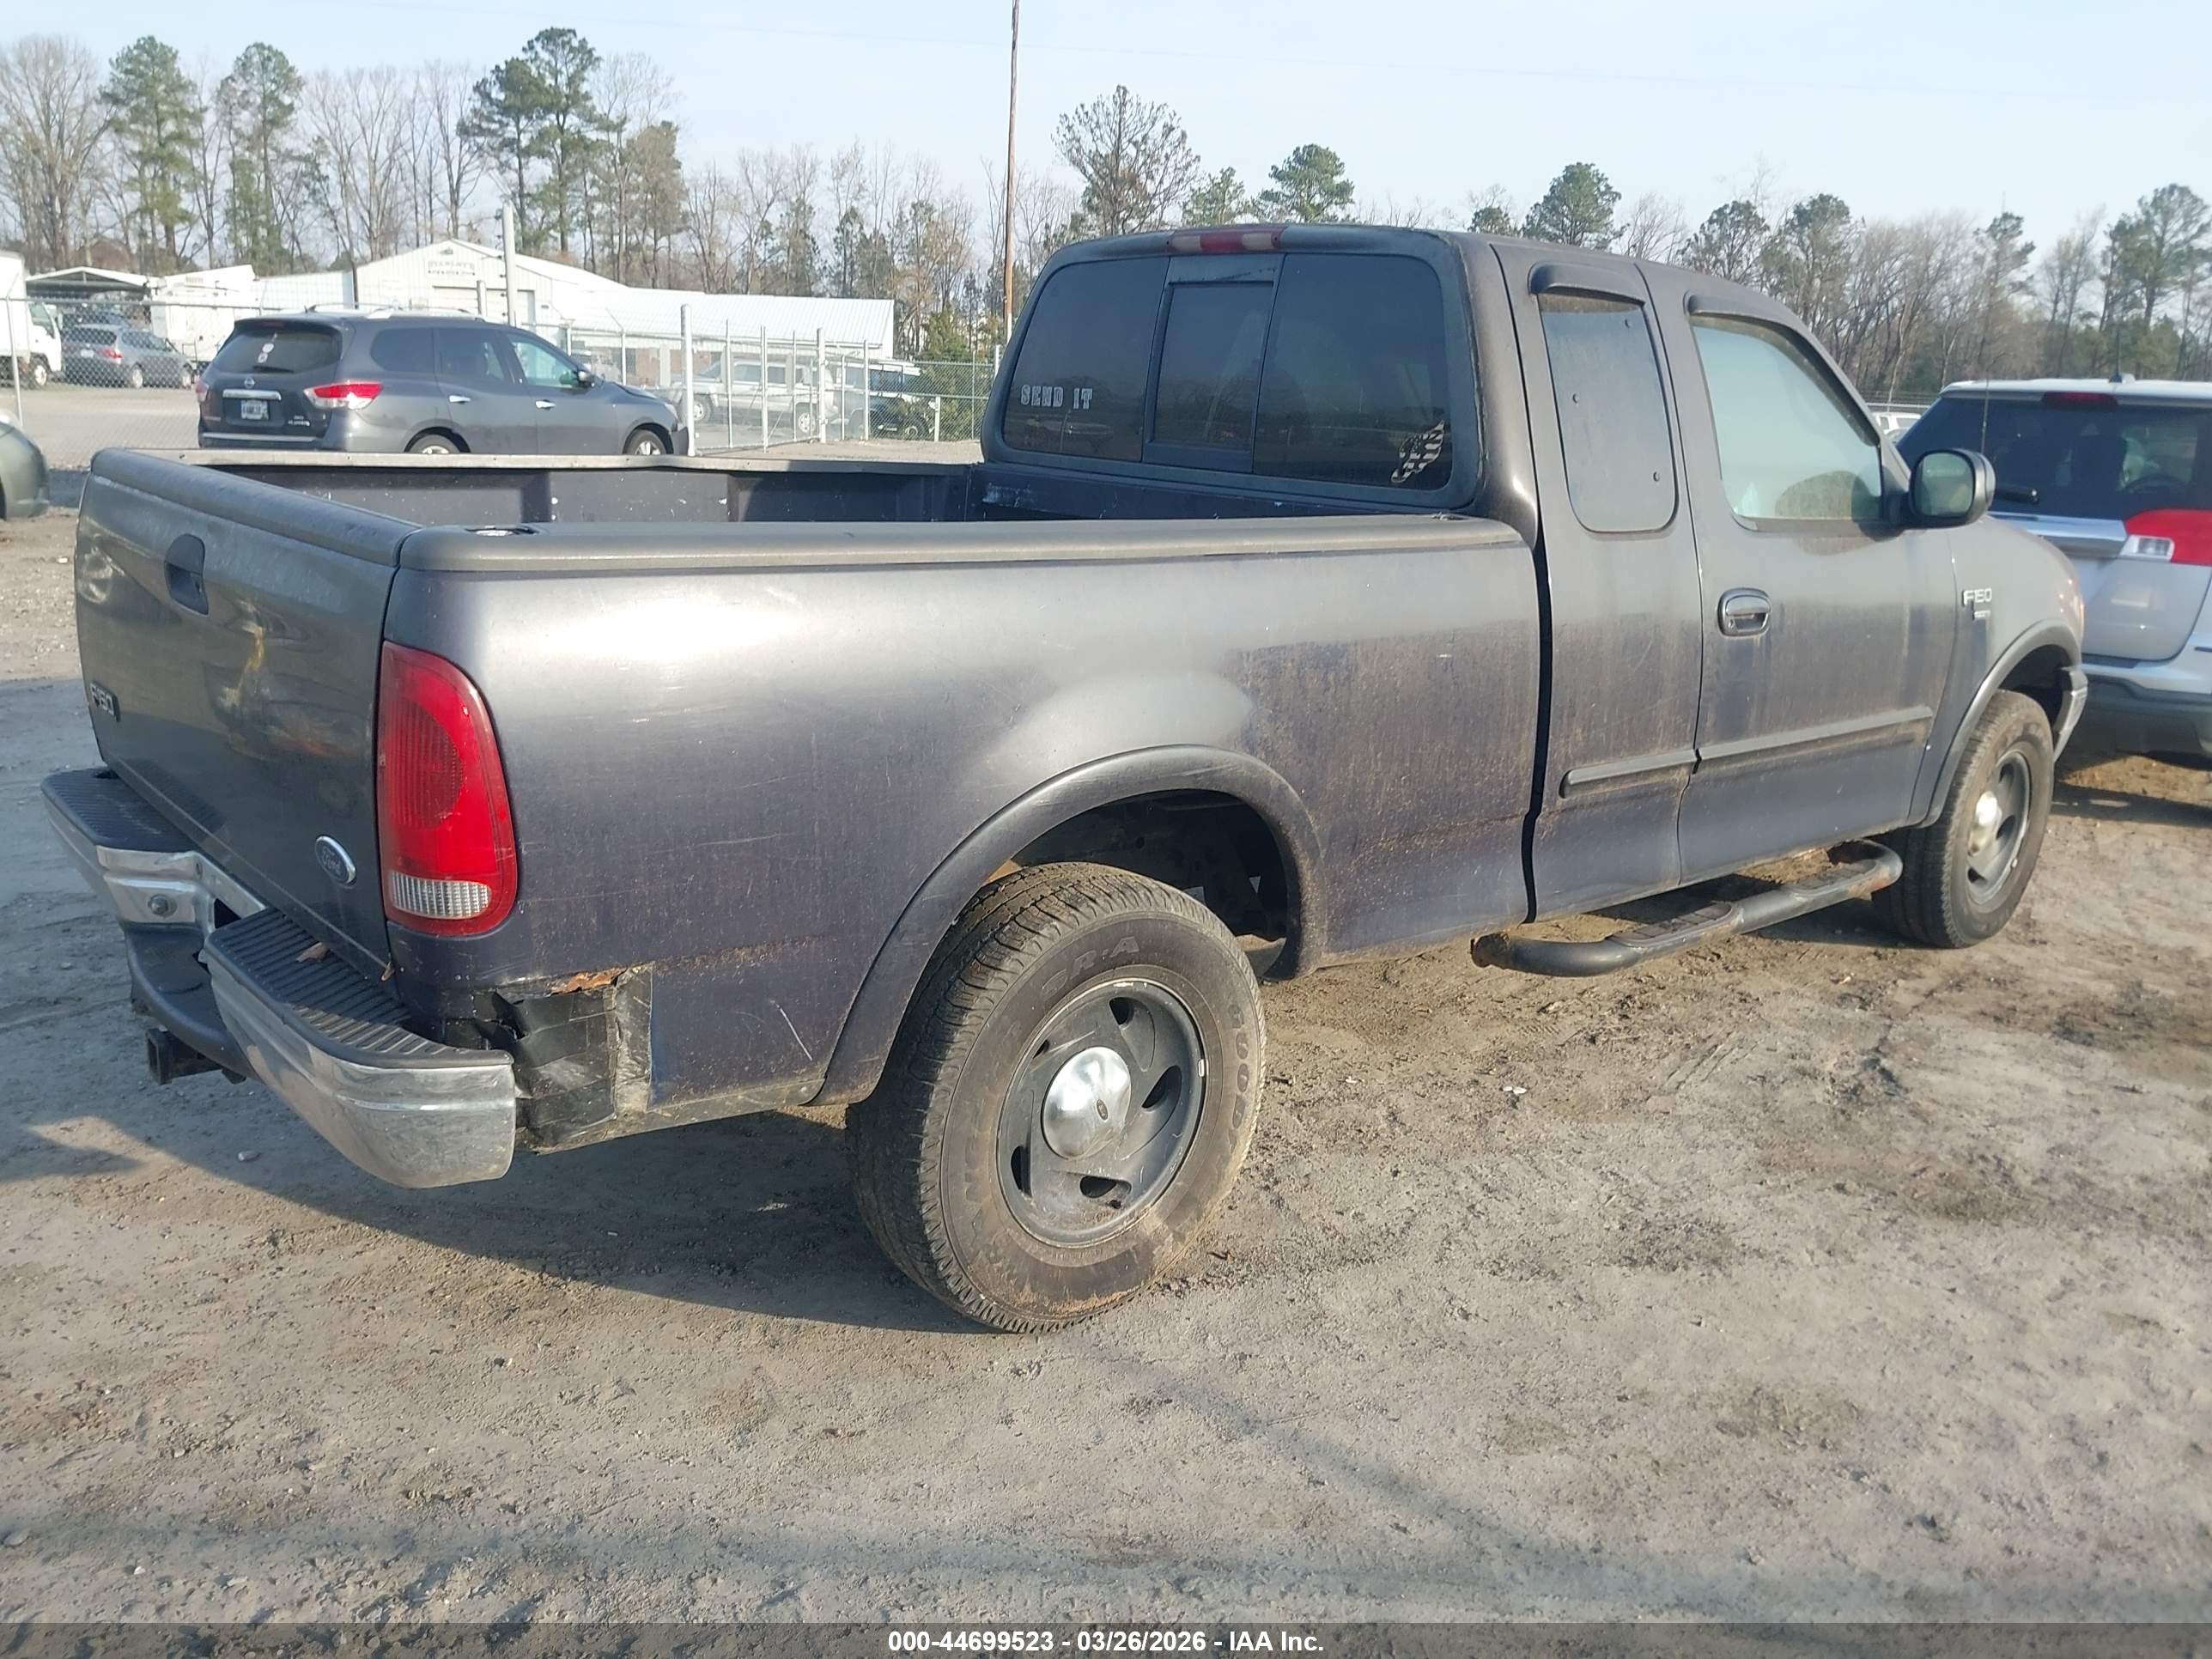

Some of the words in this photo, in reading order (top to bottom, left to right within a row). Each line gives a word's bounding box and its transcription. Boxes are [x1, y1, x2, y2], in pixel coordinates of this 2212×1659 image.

[1020, 384, 1064, 408] SEND
[1073, 387, 1093, 410] IT
[1962, 587, 1992, 605] F150
